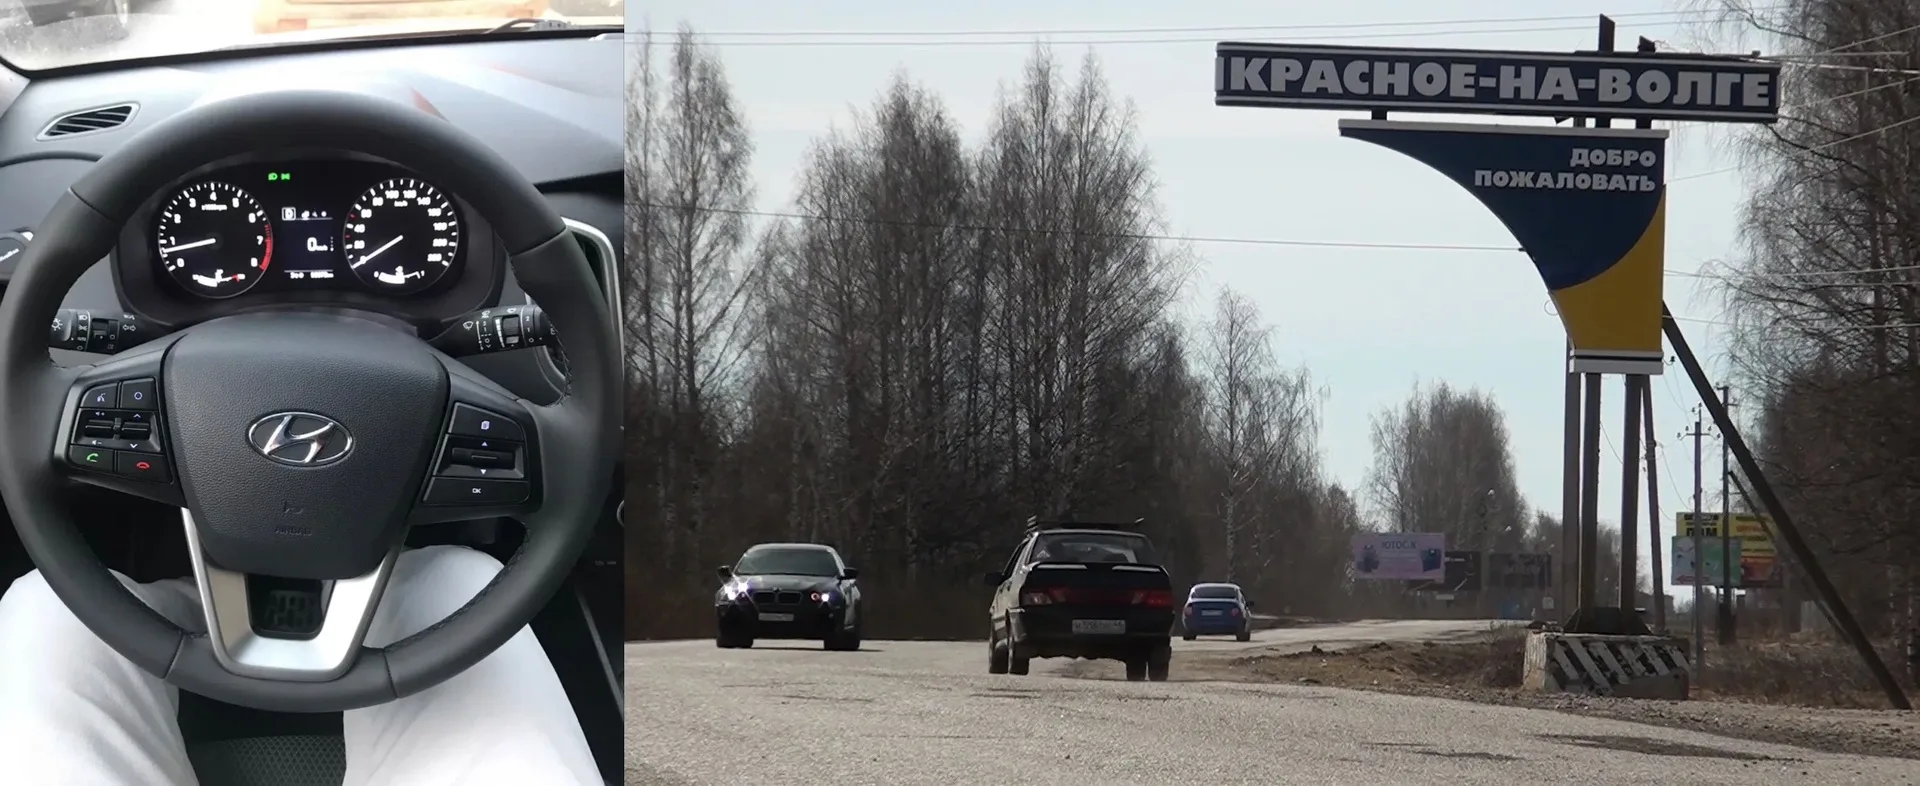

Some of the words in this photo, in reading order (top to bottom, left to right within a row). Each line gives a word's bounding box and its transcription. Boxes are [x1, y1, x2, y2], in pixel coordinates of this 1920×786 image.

[1230, 56, 1770, 107] КРАСНОЕ-НА-ВОЛГЕ
[1570, 148, 1657, 168] ДОБРО
[1474, 170, 1656, 192] ПОЖАЛОВАТЬ
[210, 191, 217, 201] 4
[189, 198, 196, 208] 3
[174, 214, 181, 223] 2
[248, 213, 256, 223] 6
[170, 236, 175, 245] 1
[257, 235, 263, 245] 7
[177, 257, 185, 268] 0
[251, 258, 258, 267] 8
